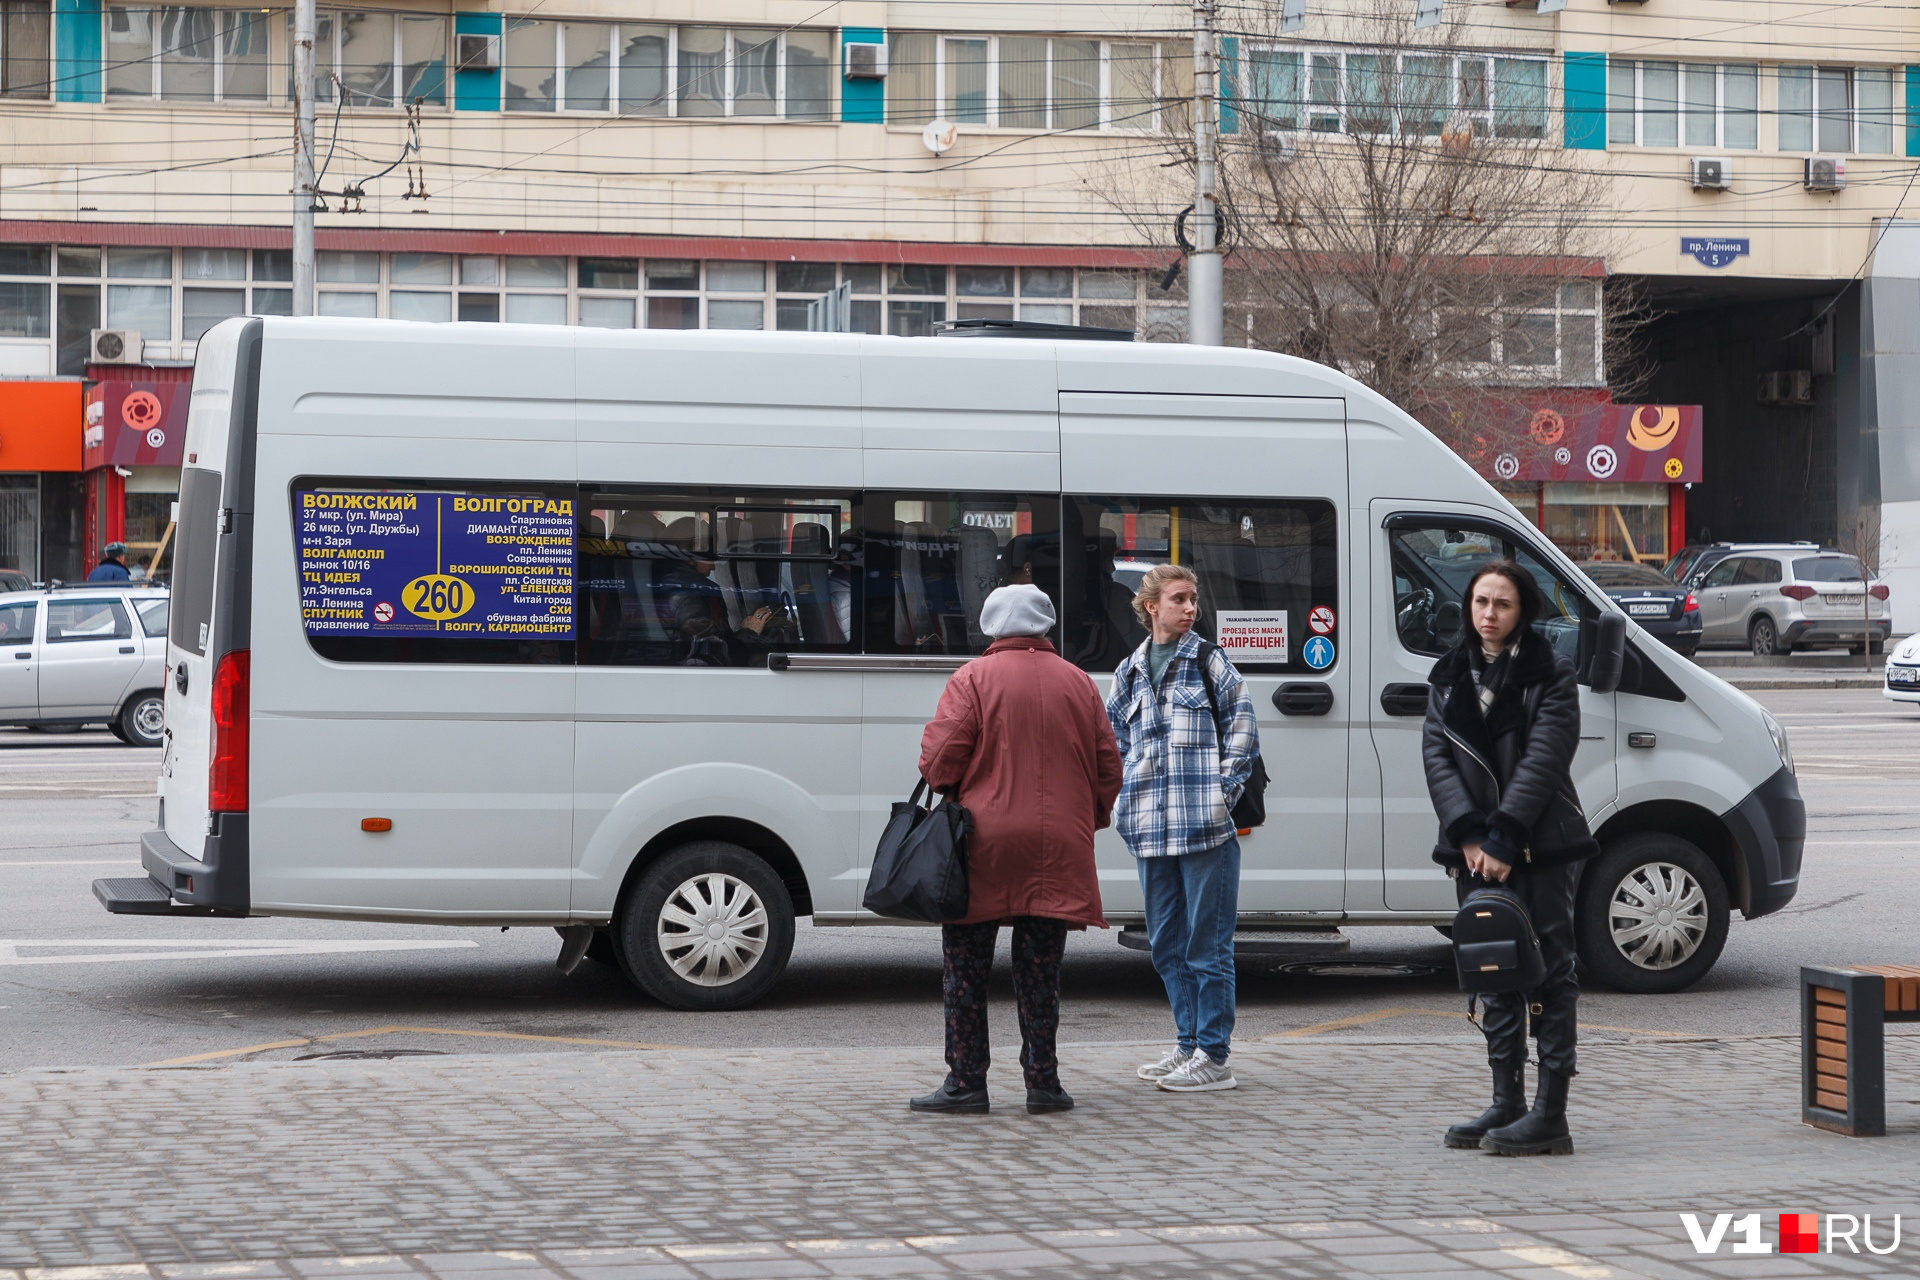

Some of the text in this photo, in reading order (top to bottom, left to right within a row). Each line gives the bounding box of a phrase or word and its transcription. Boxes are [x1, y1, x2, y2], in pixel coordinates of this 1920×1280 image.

[1689, 242, 1741, 252] пр. Ленина
[1712, 254, 1719, 265] 5
[303, 494, 417, 510] ВОЛЖСКИЙ
[454, 498, 573, 516] ВОЛГОГРАД
[304, 509, 403, 523] 37 мкр. (ул. Мира)
[510, 515, 572, 526] Спартановка
[304, 523, 420, 536] 26 мкр. (ул. Дружбы)
[467, 525, 572, 536] ДИАМАНТ (3-я школа)
[324, 536, 351, 547] Заря
[486, 536, 572, 546] ВОЗРОЖДЕНИЕ
[303, 548, 385, 559] ВОЛГАМОЛЛ
[537, 546, 572, 555] Ленина
[507, 555, 572, 564] Современник
[302, 560, 370, 571] рынок 10/16
[450, 565, 572, 576] ВОРОШИЛОВСКИЙ ТЦ
[303, 572, 361, 583] ТЦ ИДЕЯ
[523, 576, 572, 585] Советская
[303, 585, 372, 597] ул.Энгельса
[501, 585, 572, 594] ул. ЕЛЕЦКАЯ
[414, 580, 463, 613] 260
[514, 595, 572, 605] Китай город
[322, 598, 364, 608] Ленина
[303, 609, 363, 618] СПУТНИК
[549, 606, 572, 614] СХИ
[487, 614, 572, 623] обувная фабрика
[445, 623, 485, 633] ВОЛГУ,
[488, 624, 572, 634] КАРДИОЦЕНТР
[1220, 637, 1285, 649] ЗАПРЕЩЕН!
